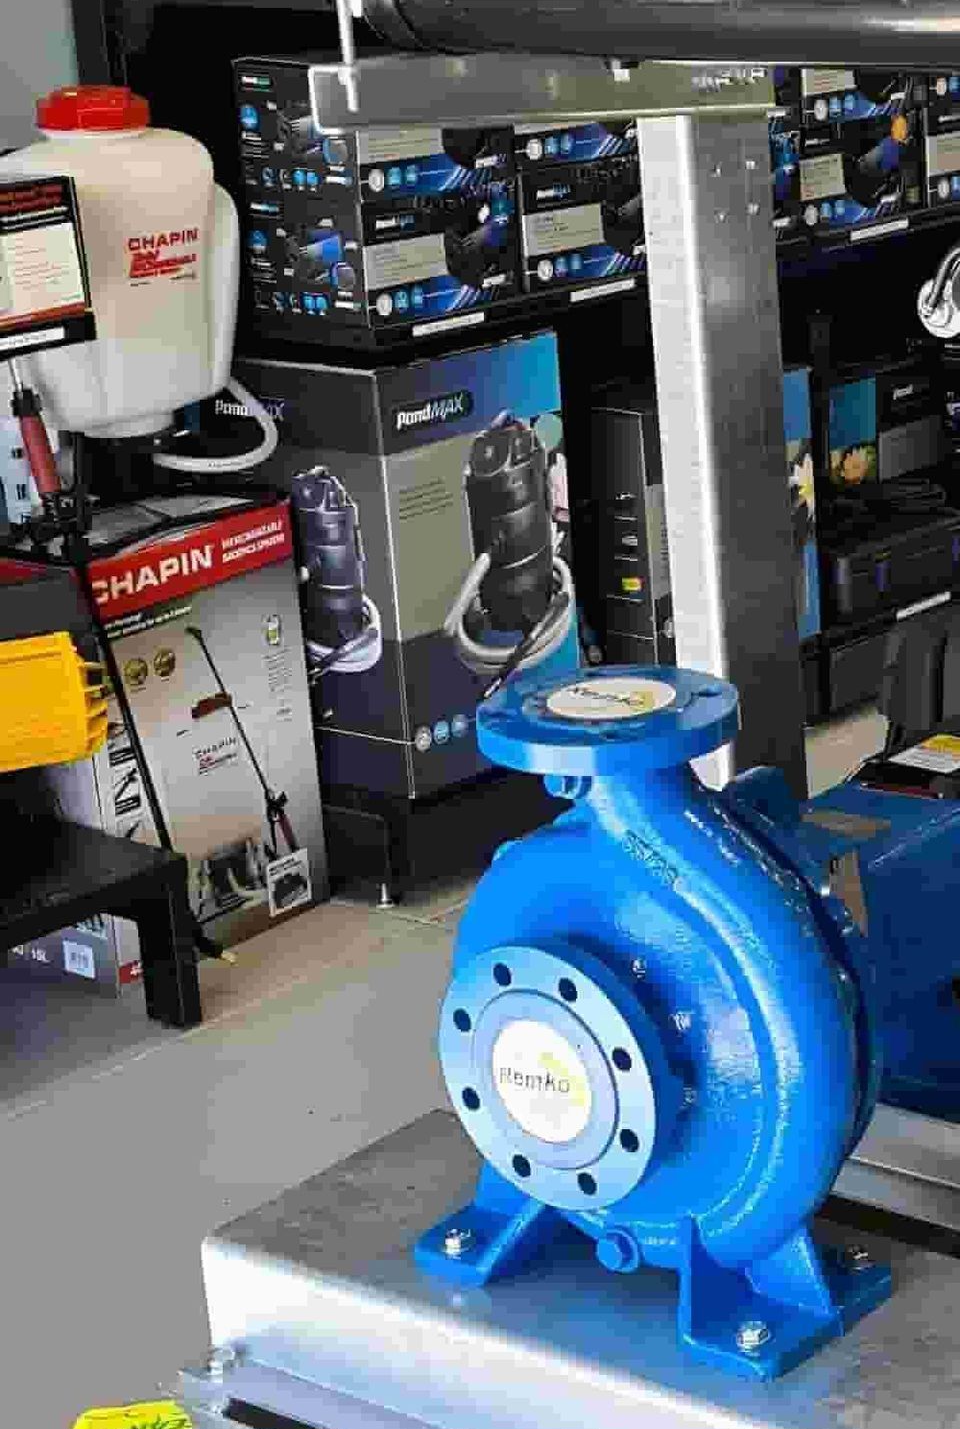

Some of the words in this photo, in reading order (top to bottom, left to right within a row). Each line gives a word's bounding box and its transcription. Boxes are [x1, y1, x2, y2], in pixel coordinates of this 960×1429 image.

[128, 230, 198, 252] CHAPIN
[397, 392, 463, 430] PondMAX
[92, 545, 213, 604] CHAPIN
[499, 1067, 569, 1093] Remko
